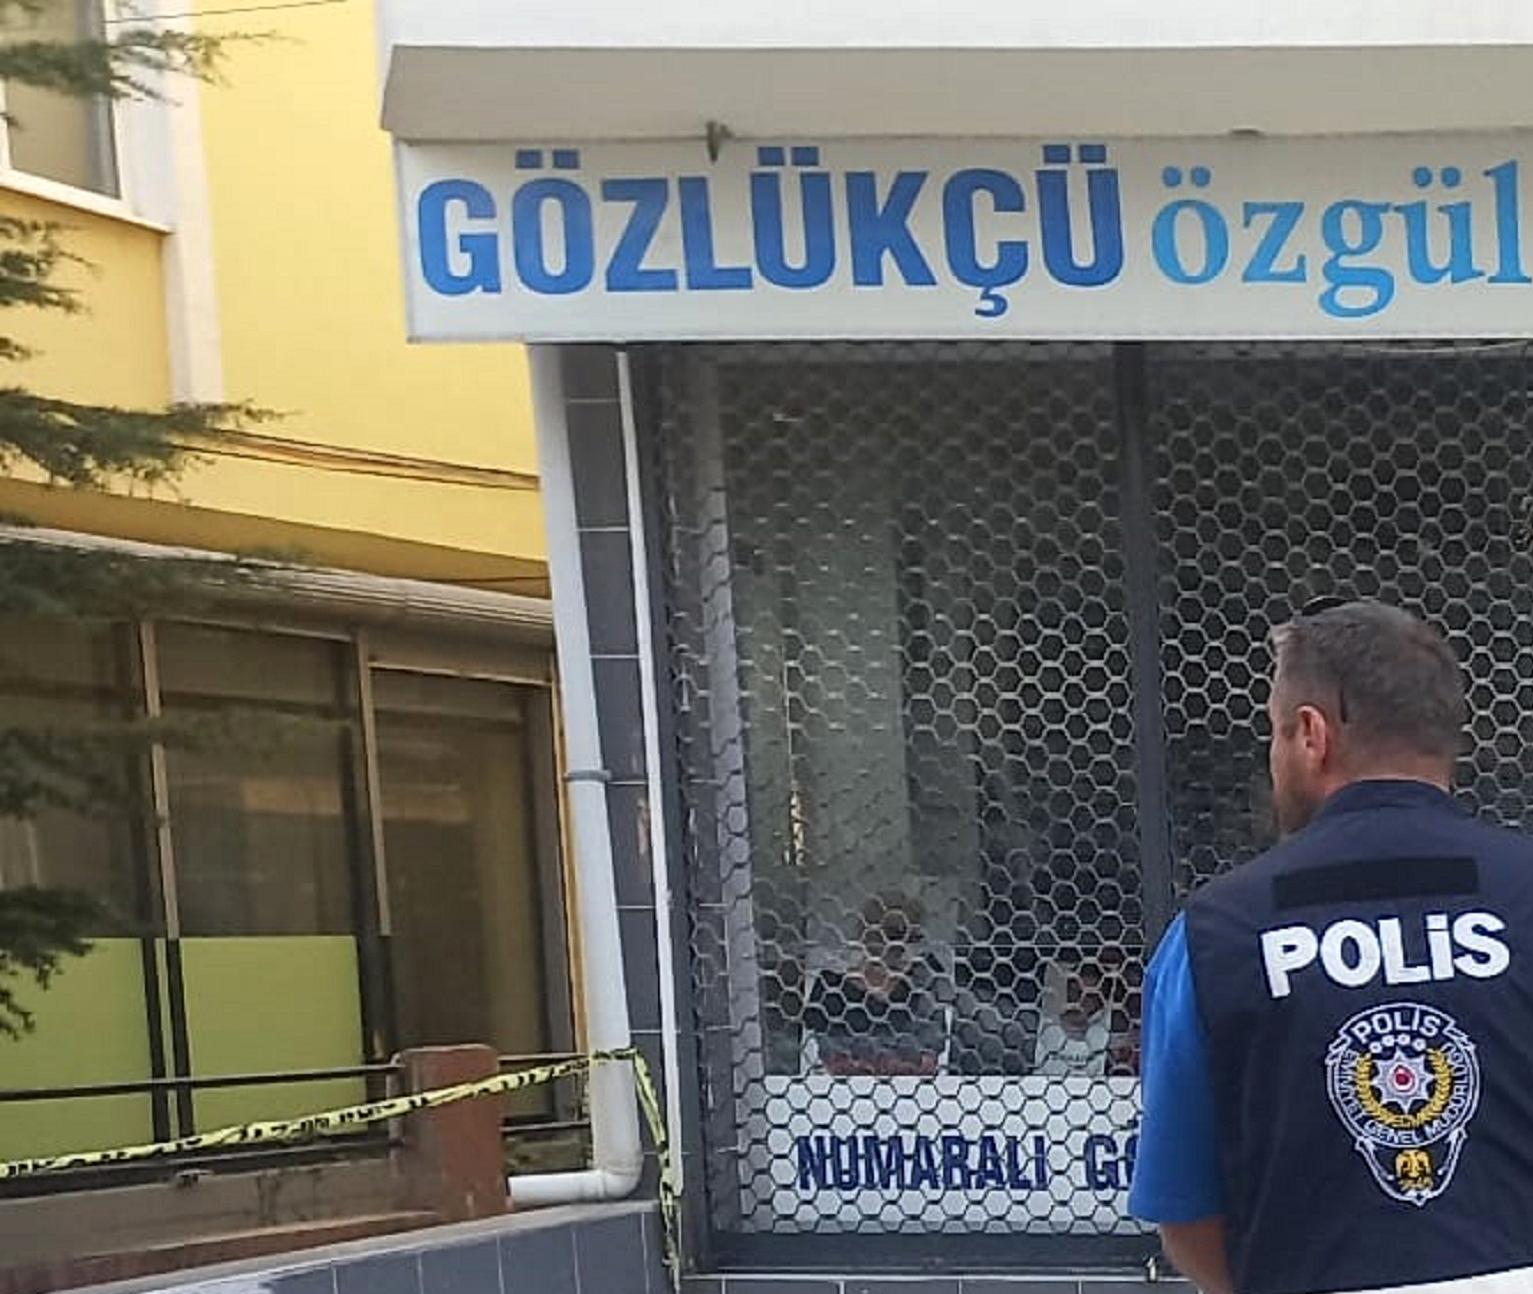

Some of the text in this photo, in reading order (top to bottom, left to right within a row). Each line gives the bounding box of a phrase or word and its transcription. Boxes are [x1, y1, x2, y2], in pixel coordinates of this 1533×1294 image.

[415, 144, 1124, 316] GÖZLÜKÇÜ
[1151, 160, 1533, 316] özgül
[798, 1134, 1049, 1192] NUMARALI
